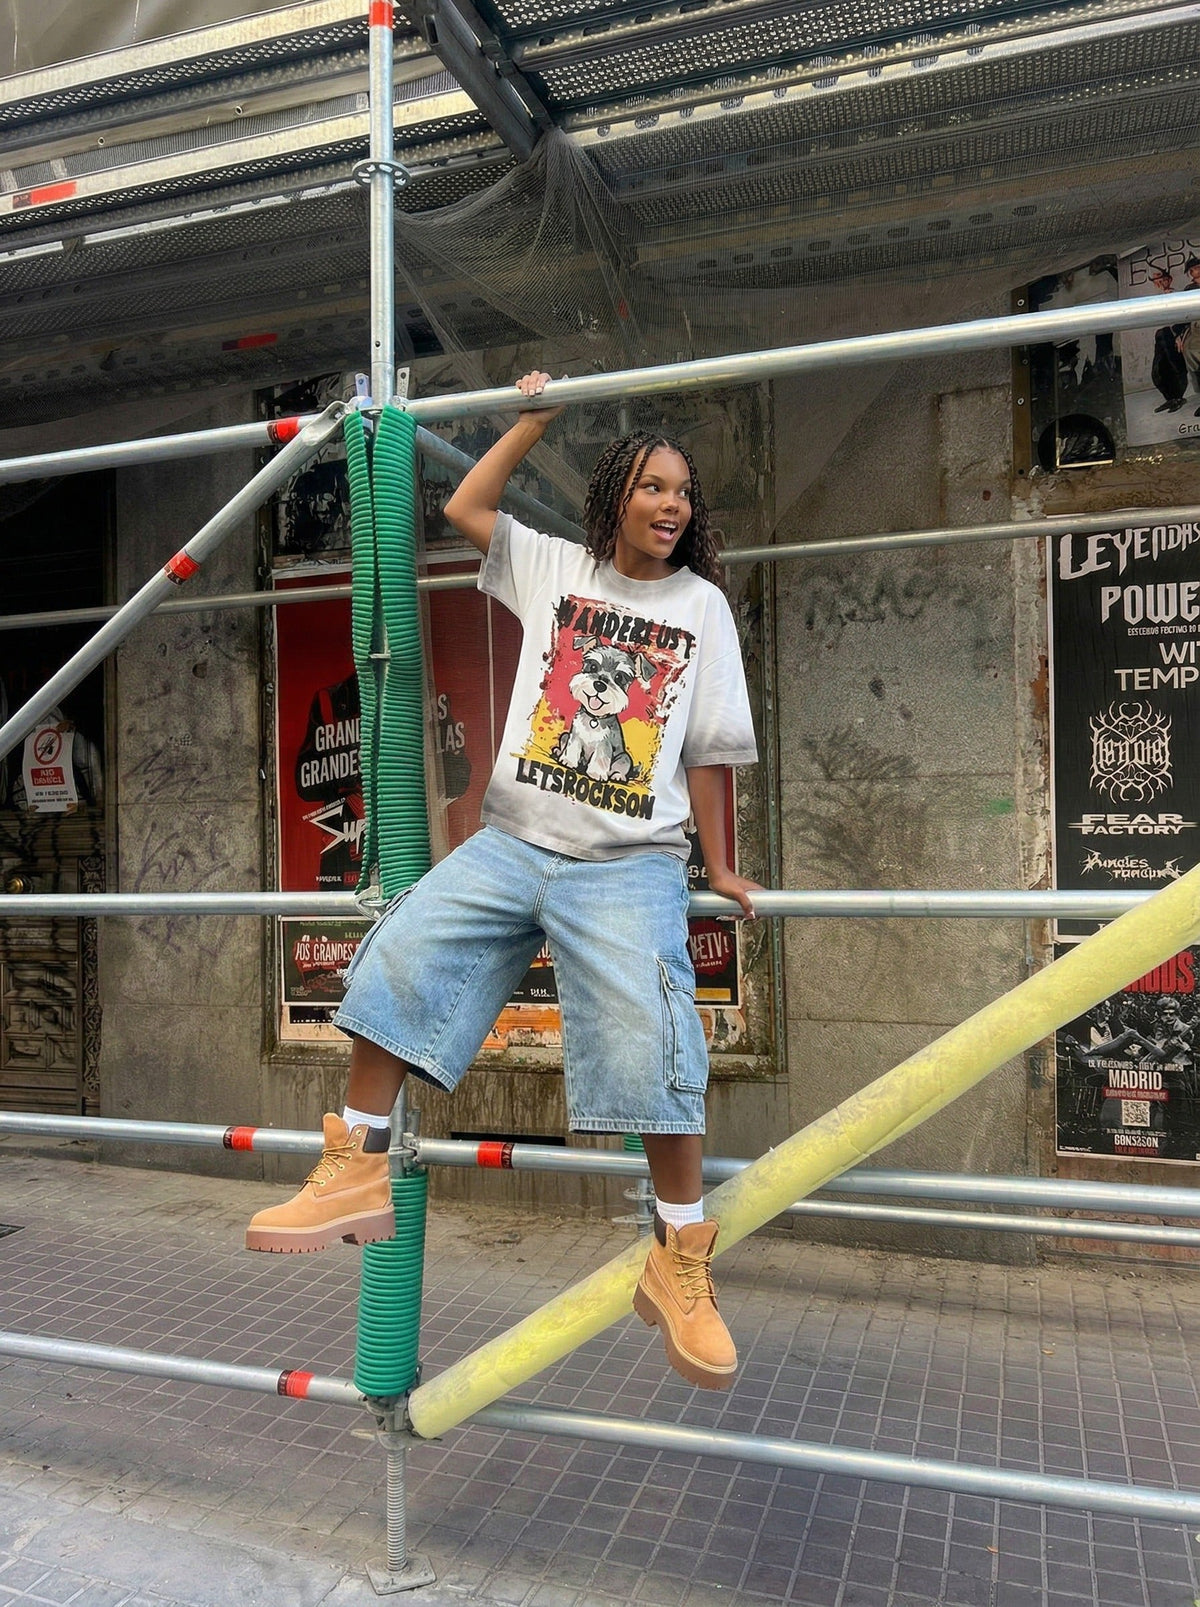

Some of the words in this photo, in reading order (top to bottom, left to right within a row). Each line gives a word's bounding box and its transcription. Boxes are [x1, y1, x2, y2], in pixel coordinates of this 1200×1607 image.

[1129, 251, 1198, 286] ESP
[1114, 667, 1200, 691] TEMP
[1081, 813, 1183, 825] FEAR
[1081, 825, 1184, 835] FACTORY
[313, 943, 354, 961] GRANDES
[1108, 1069, 1163, 1091] MADRID
